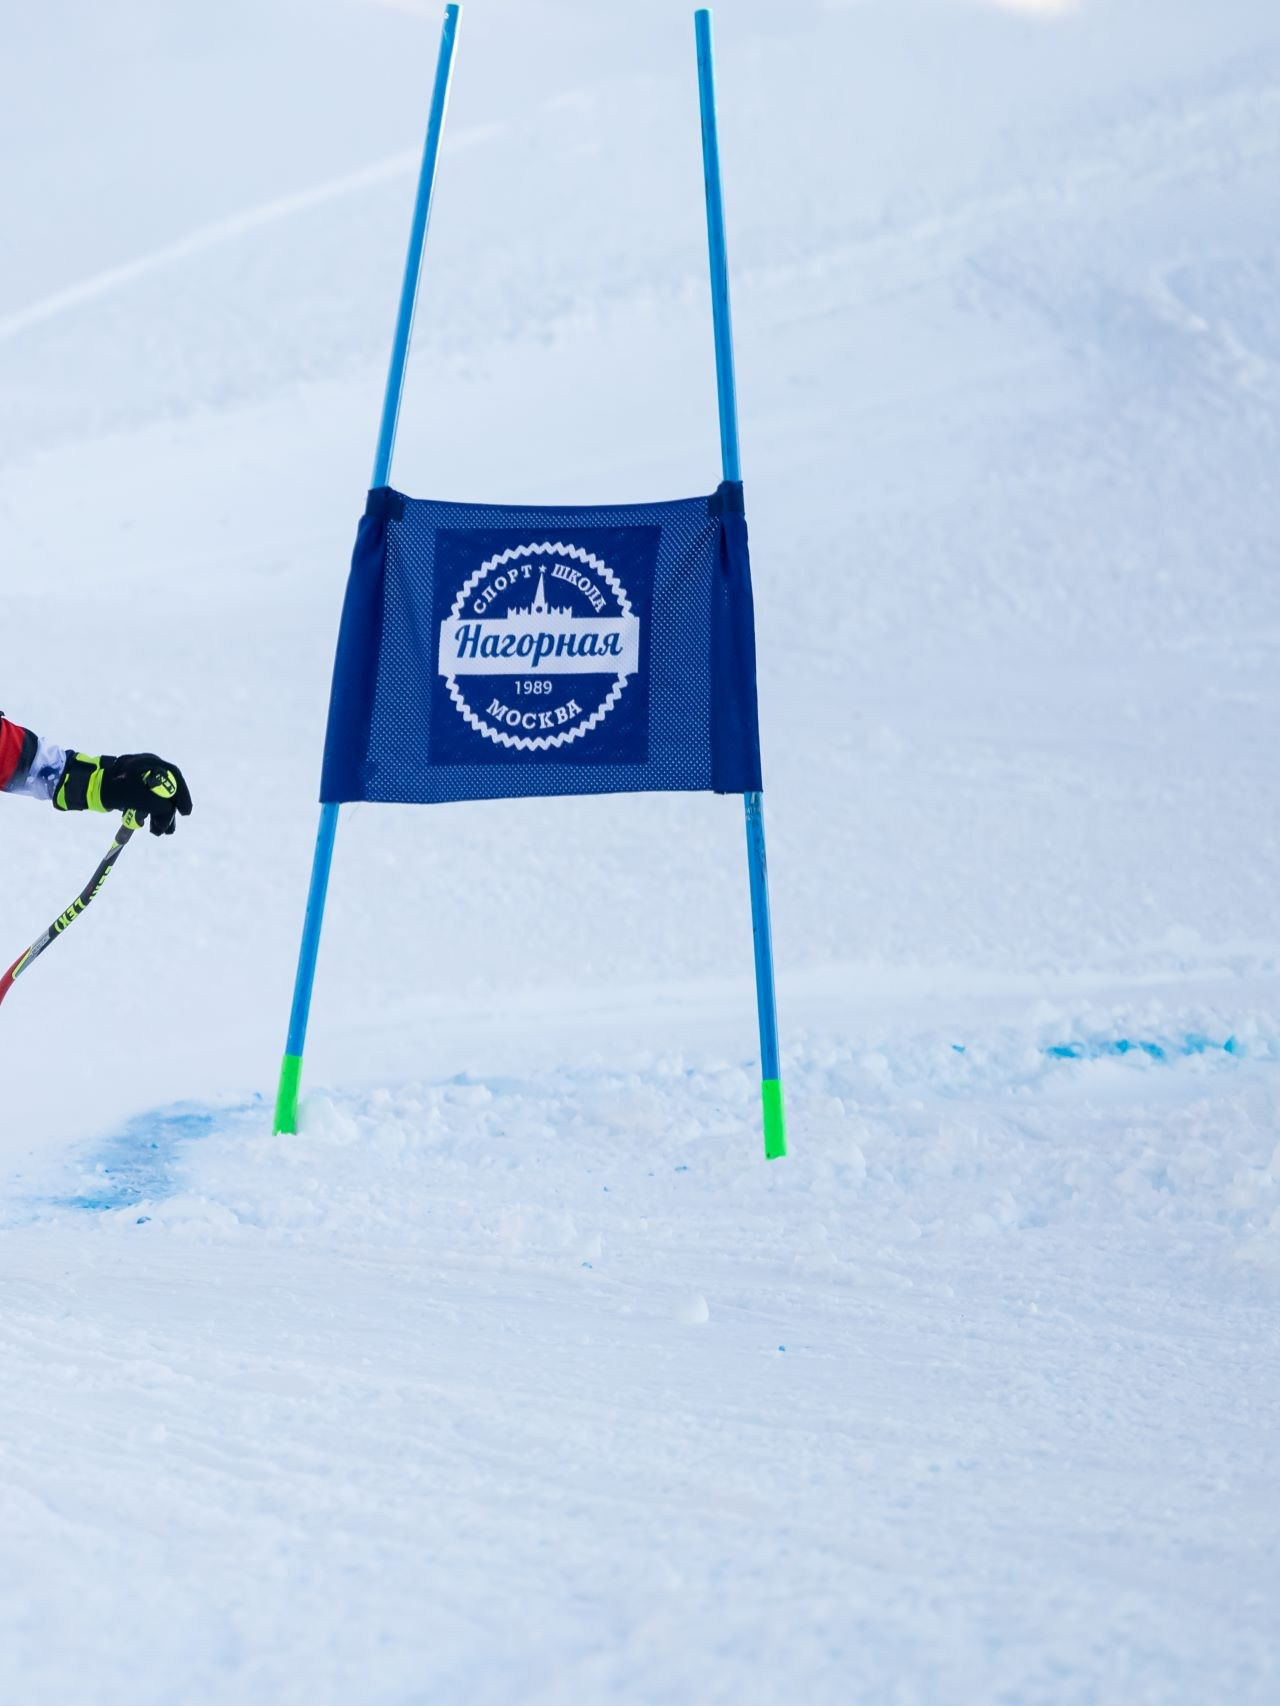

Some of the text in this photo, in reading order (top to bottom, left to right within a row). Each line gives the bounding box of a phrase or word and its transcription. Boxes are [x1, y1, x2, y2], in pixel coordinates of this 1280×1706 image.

[473, 563, 607, 614] СПОРТ ШКОЛА
[454, 623, 624, 668] Нагорная
[515, 681, 552, 695] 1989
[486, 699, 583, 729] МОСКВА
[54, 897, 87, 934] LEKI
